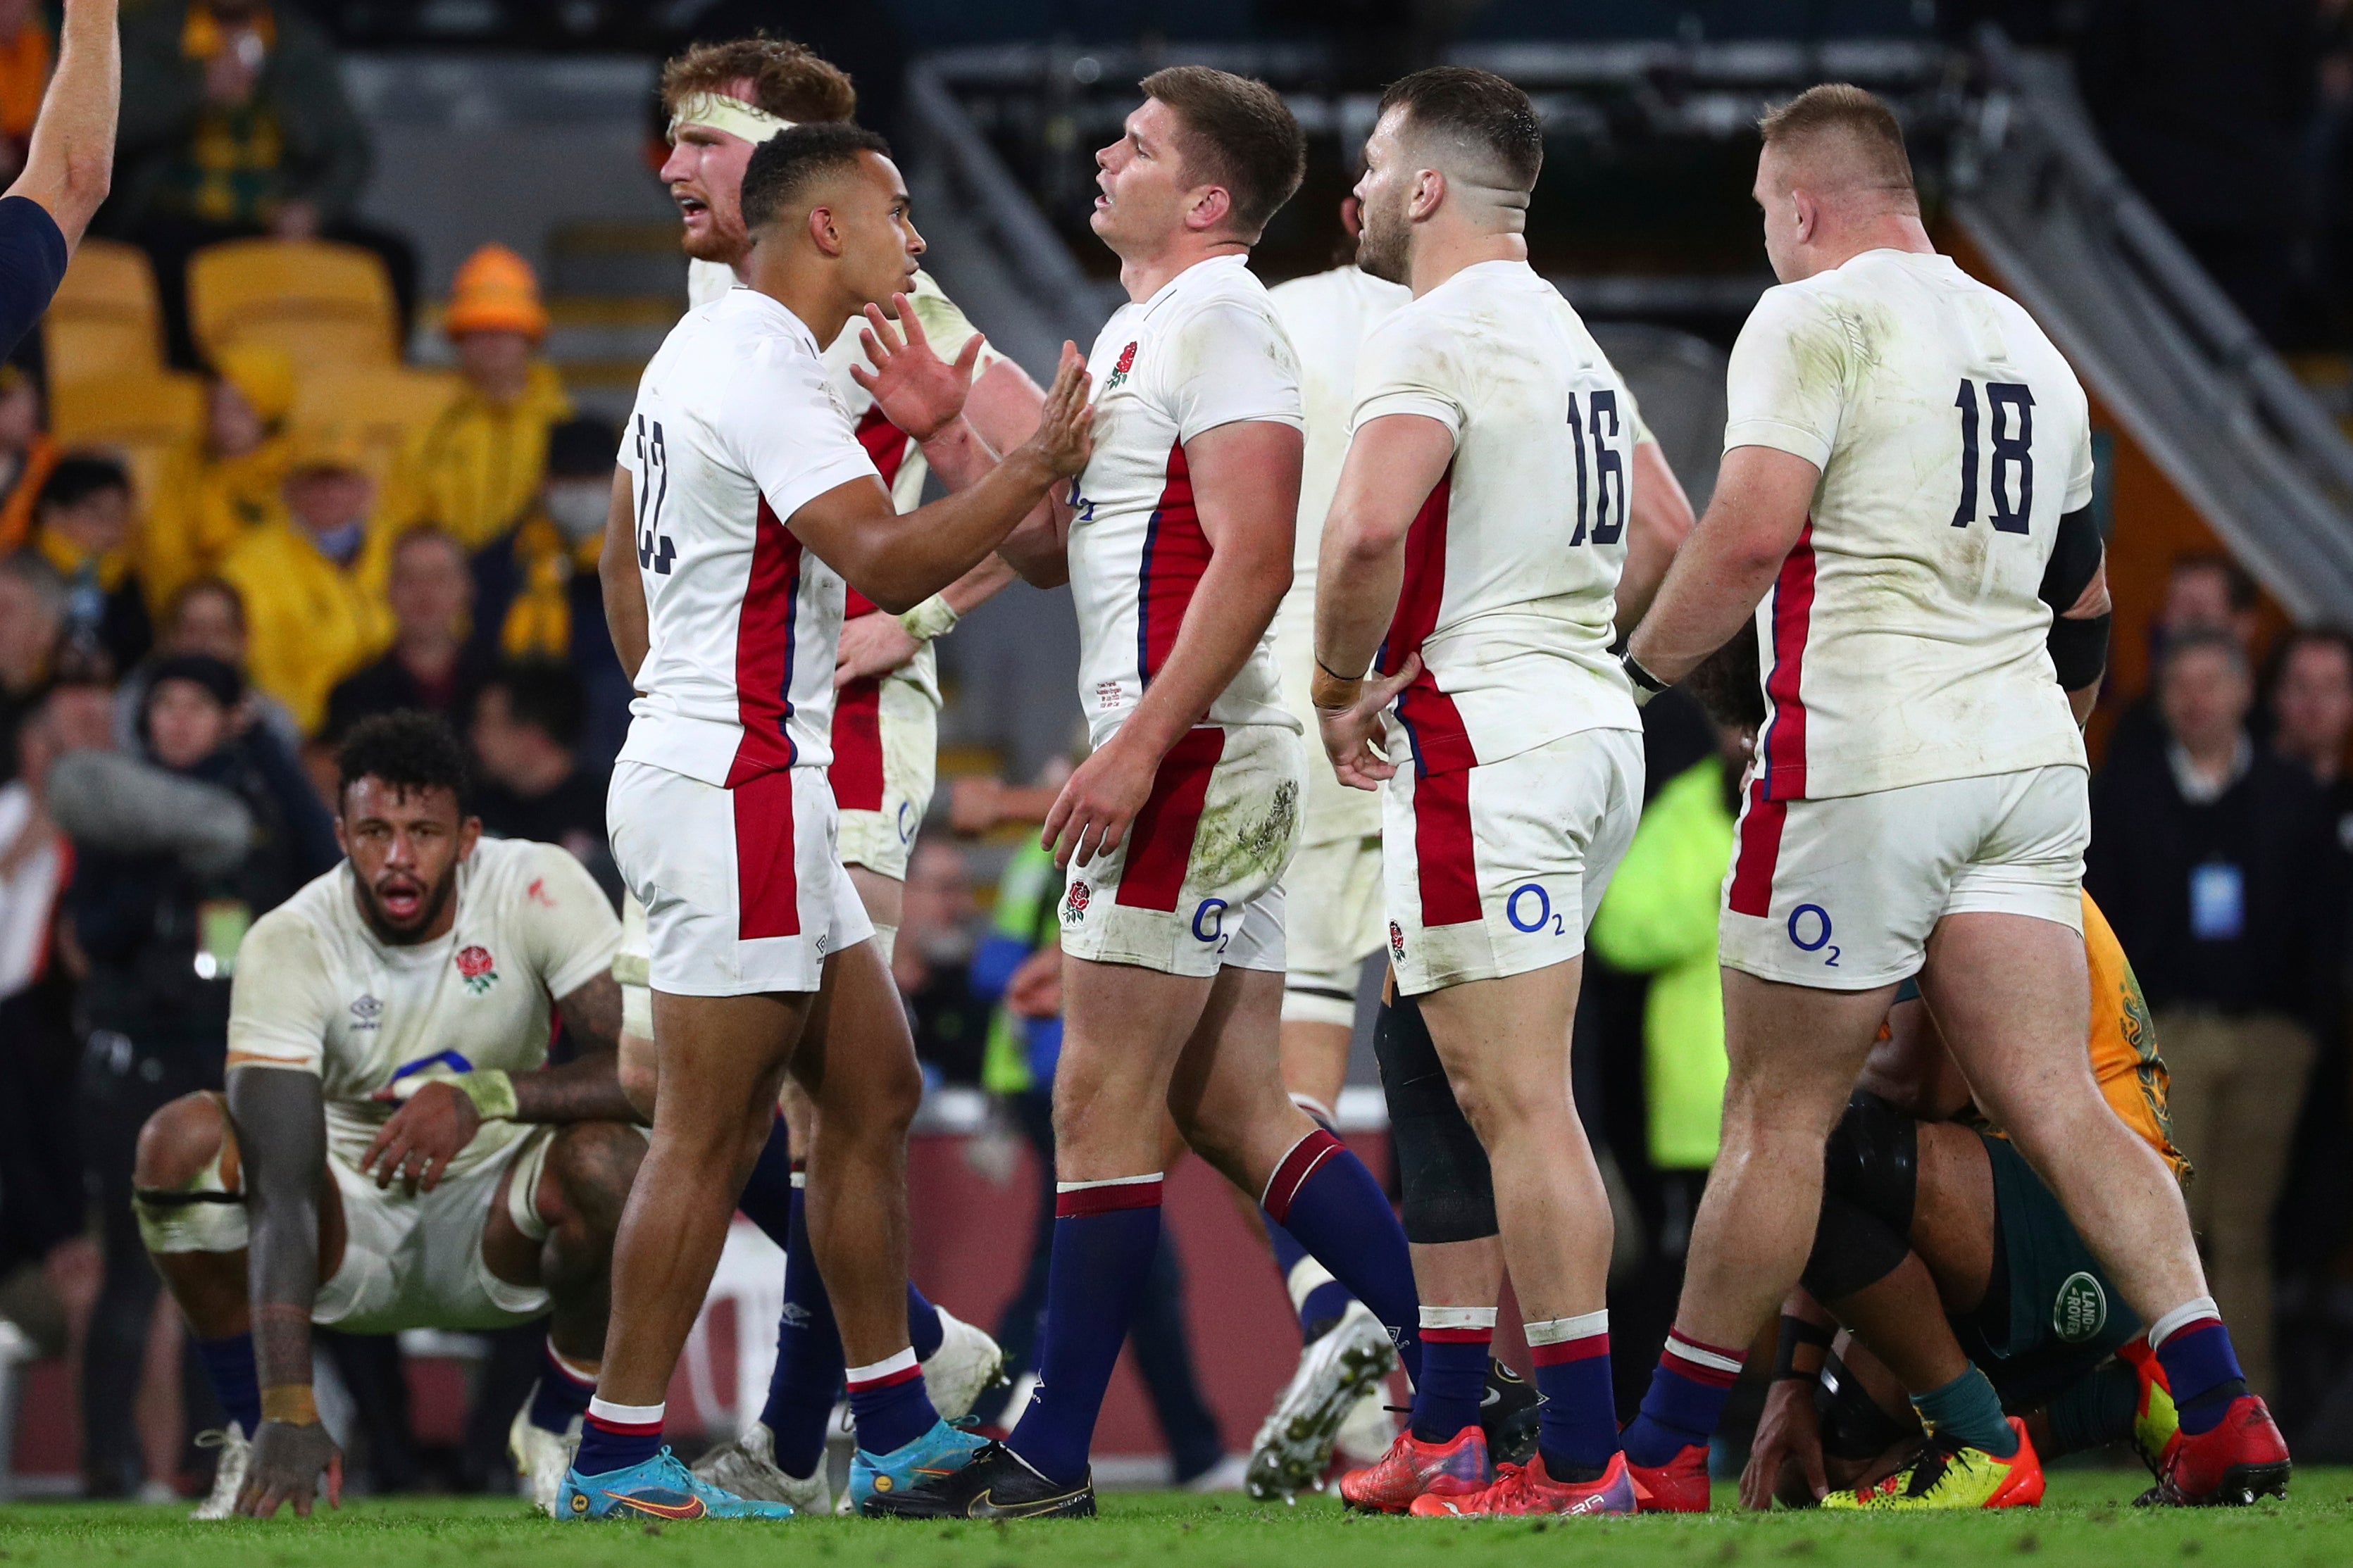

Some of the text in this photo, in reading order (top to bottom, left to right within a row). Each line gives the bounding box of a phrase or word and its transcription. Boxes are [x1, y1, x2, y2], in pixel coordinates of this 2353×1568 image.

[1567, 390, 1625, 546] 16
[1950, 377, 2037, 535] 18
[1506, 884, 1565, 936] O2
[1787, 903, 1841, 967] O2
[2067, 1296, 2082, 1336] ROVER
[2082, 1291, 2096, 1326] LAND
